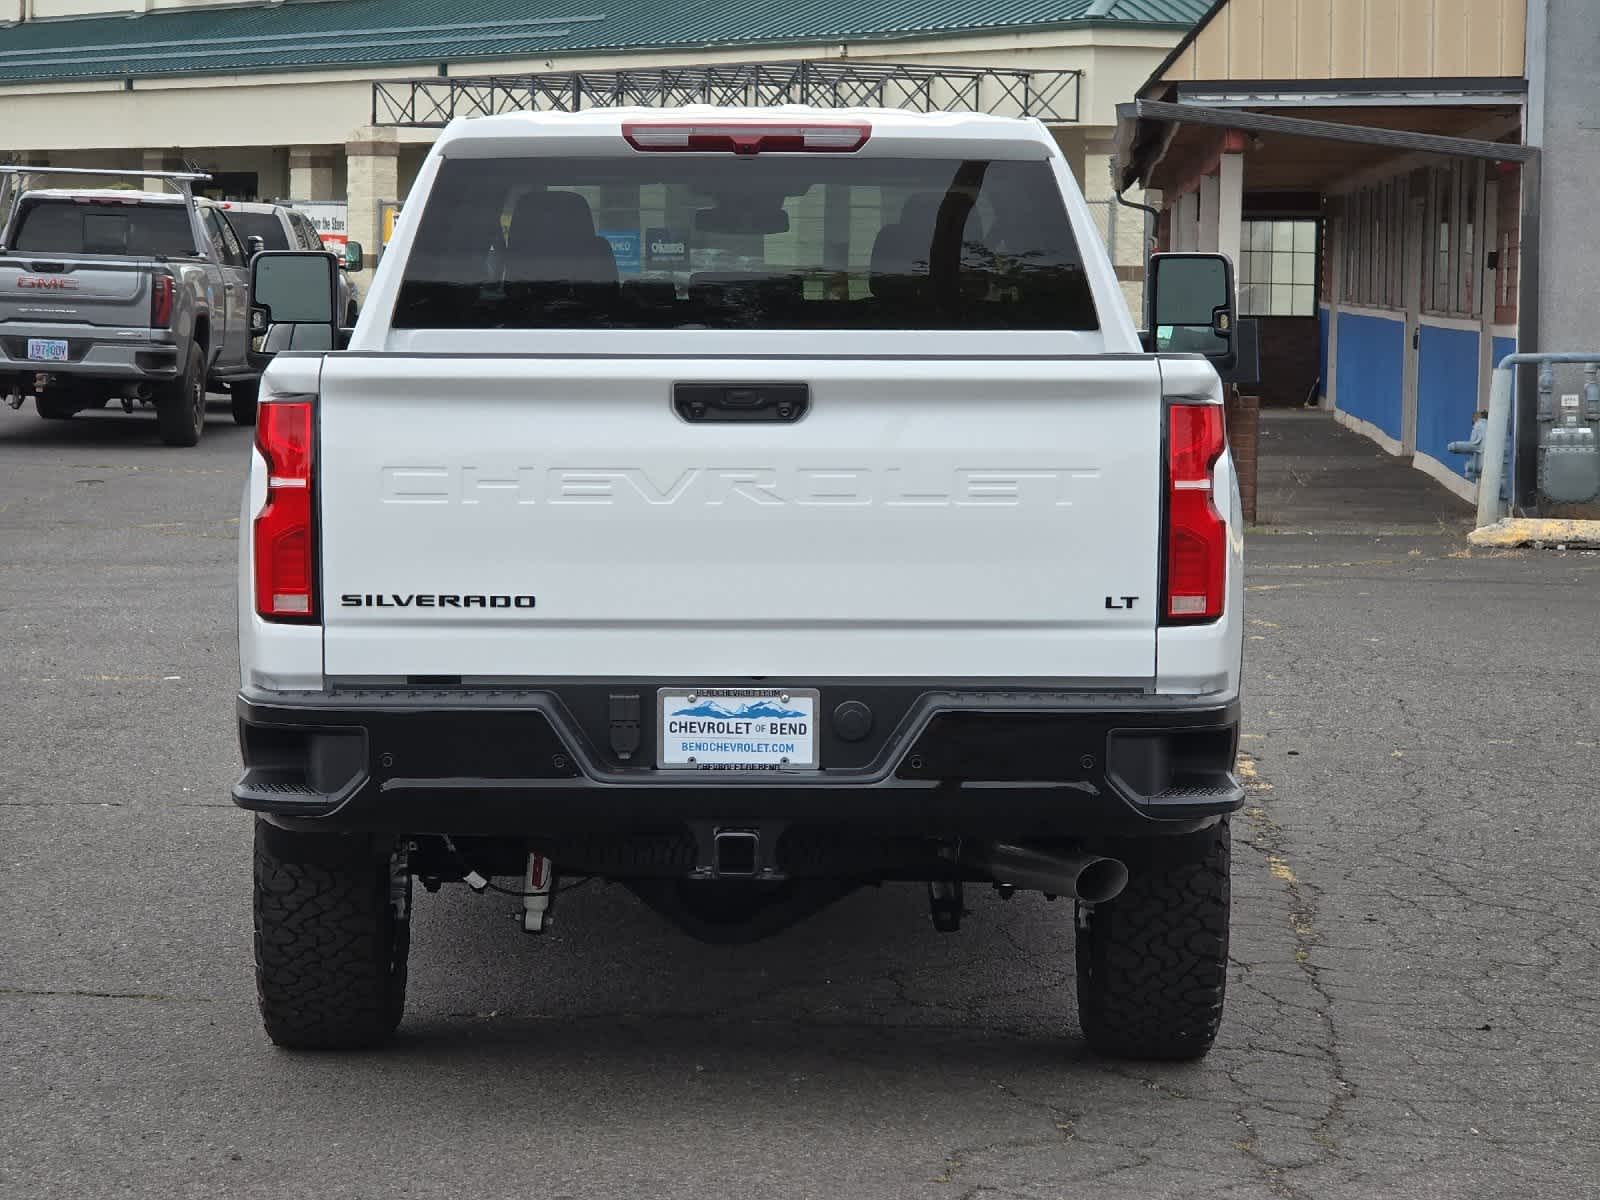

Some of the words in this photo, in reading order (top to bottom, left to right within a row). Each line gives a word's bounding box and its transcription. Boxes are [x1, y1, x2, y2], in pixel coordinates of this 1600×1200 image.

[18, 276, 79, 290] GMC
[377, 465, 1102, 507] CHEVROLET
[341, 594, 536, 608] SILVERADO
[1104, 596, 1139, 609] LT
[669, 721, 752, 735] CHEVROLET
[755, 725, 767, 733] OF
[770, 723, 807, 735] BEND
[681, 742, 795, 753] BENDCHEVROLET.COM
